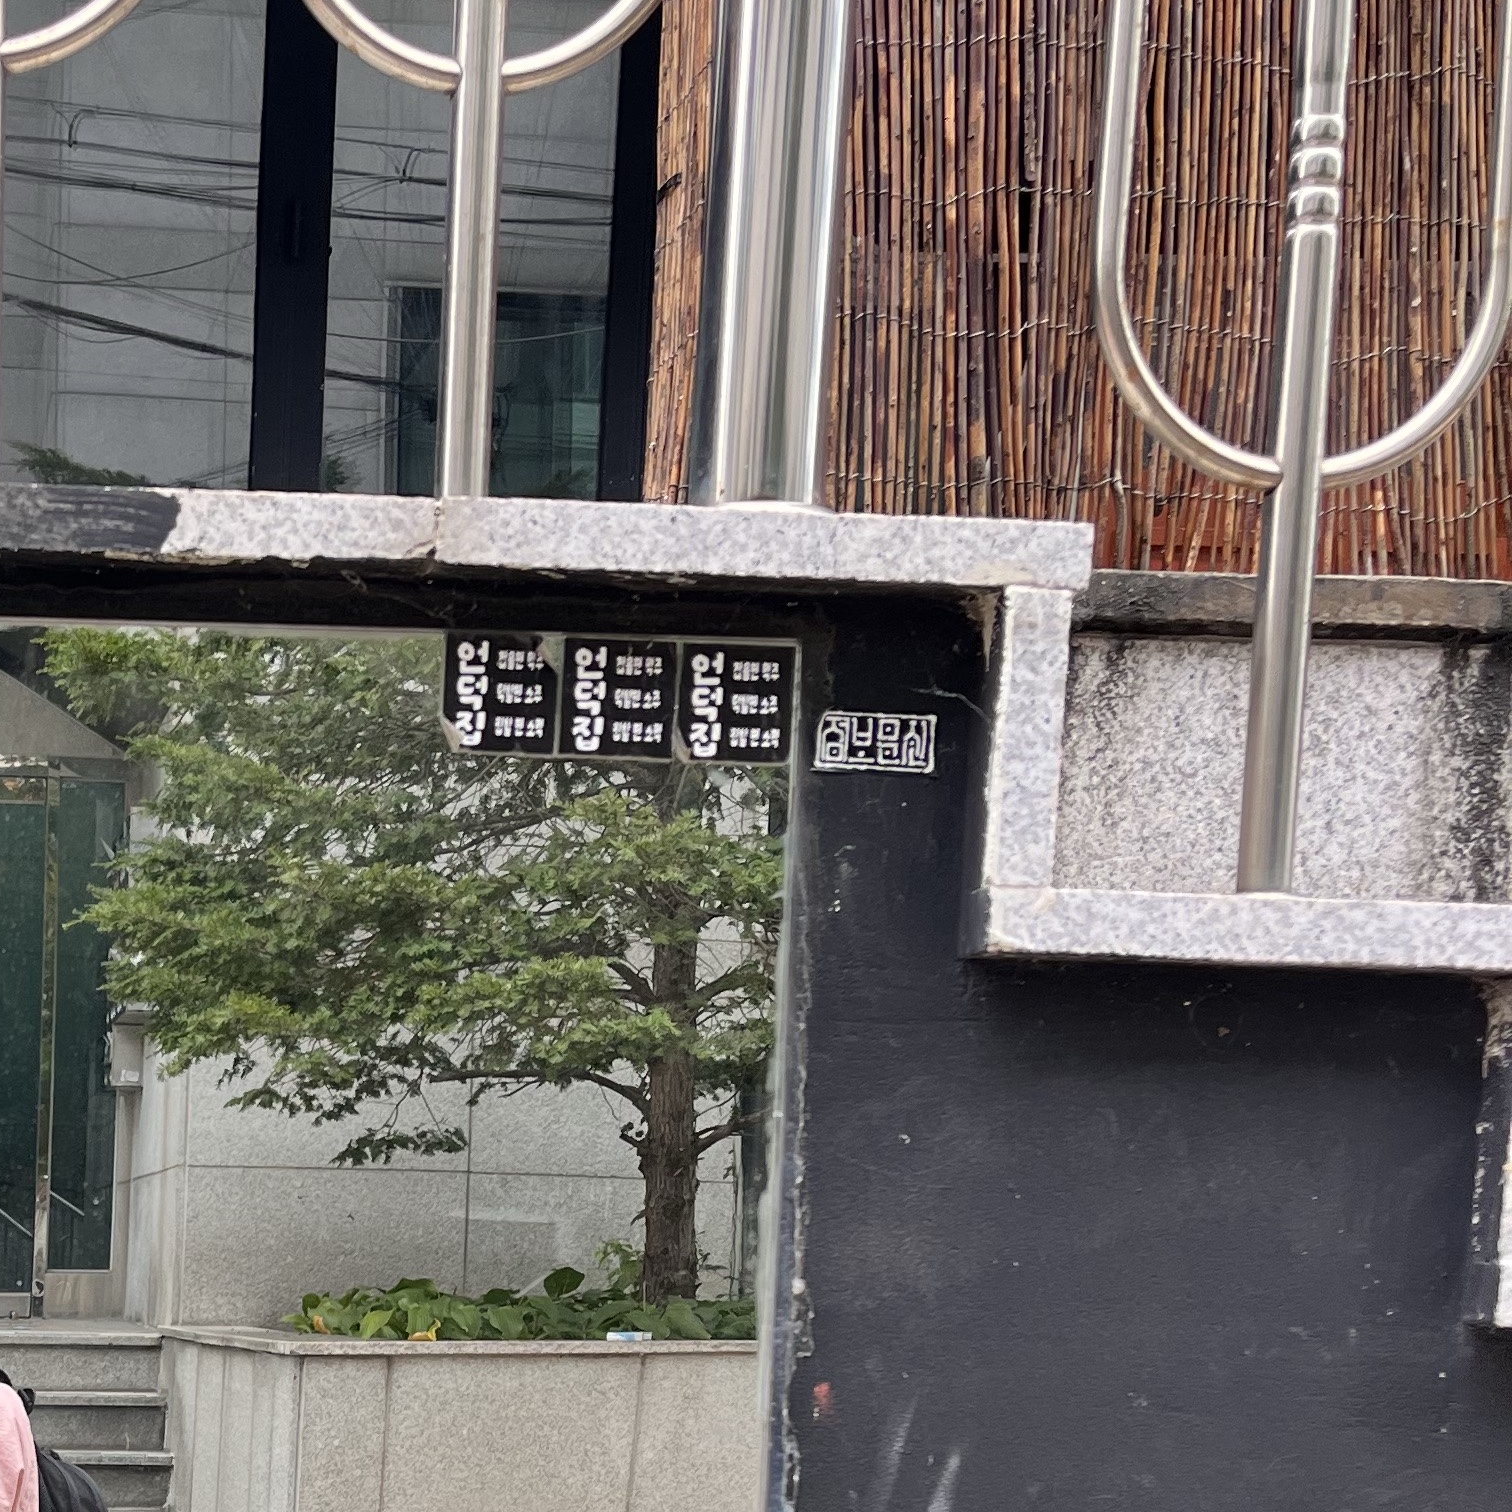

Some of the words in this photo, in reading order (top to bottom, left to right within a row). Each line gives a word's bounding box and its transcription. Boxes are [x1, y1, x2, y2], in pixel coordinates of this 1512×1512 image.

[455, 640, 490, 746] 언덕집
[572, 646, 608, 751] 언덕집
[689, 651, 725, 757] 언덕집
